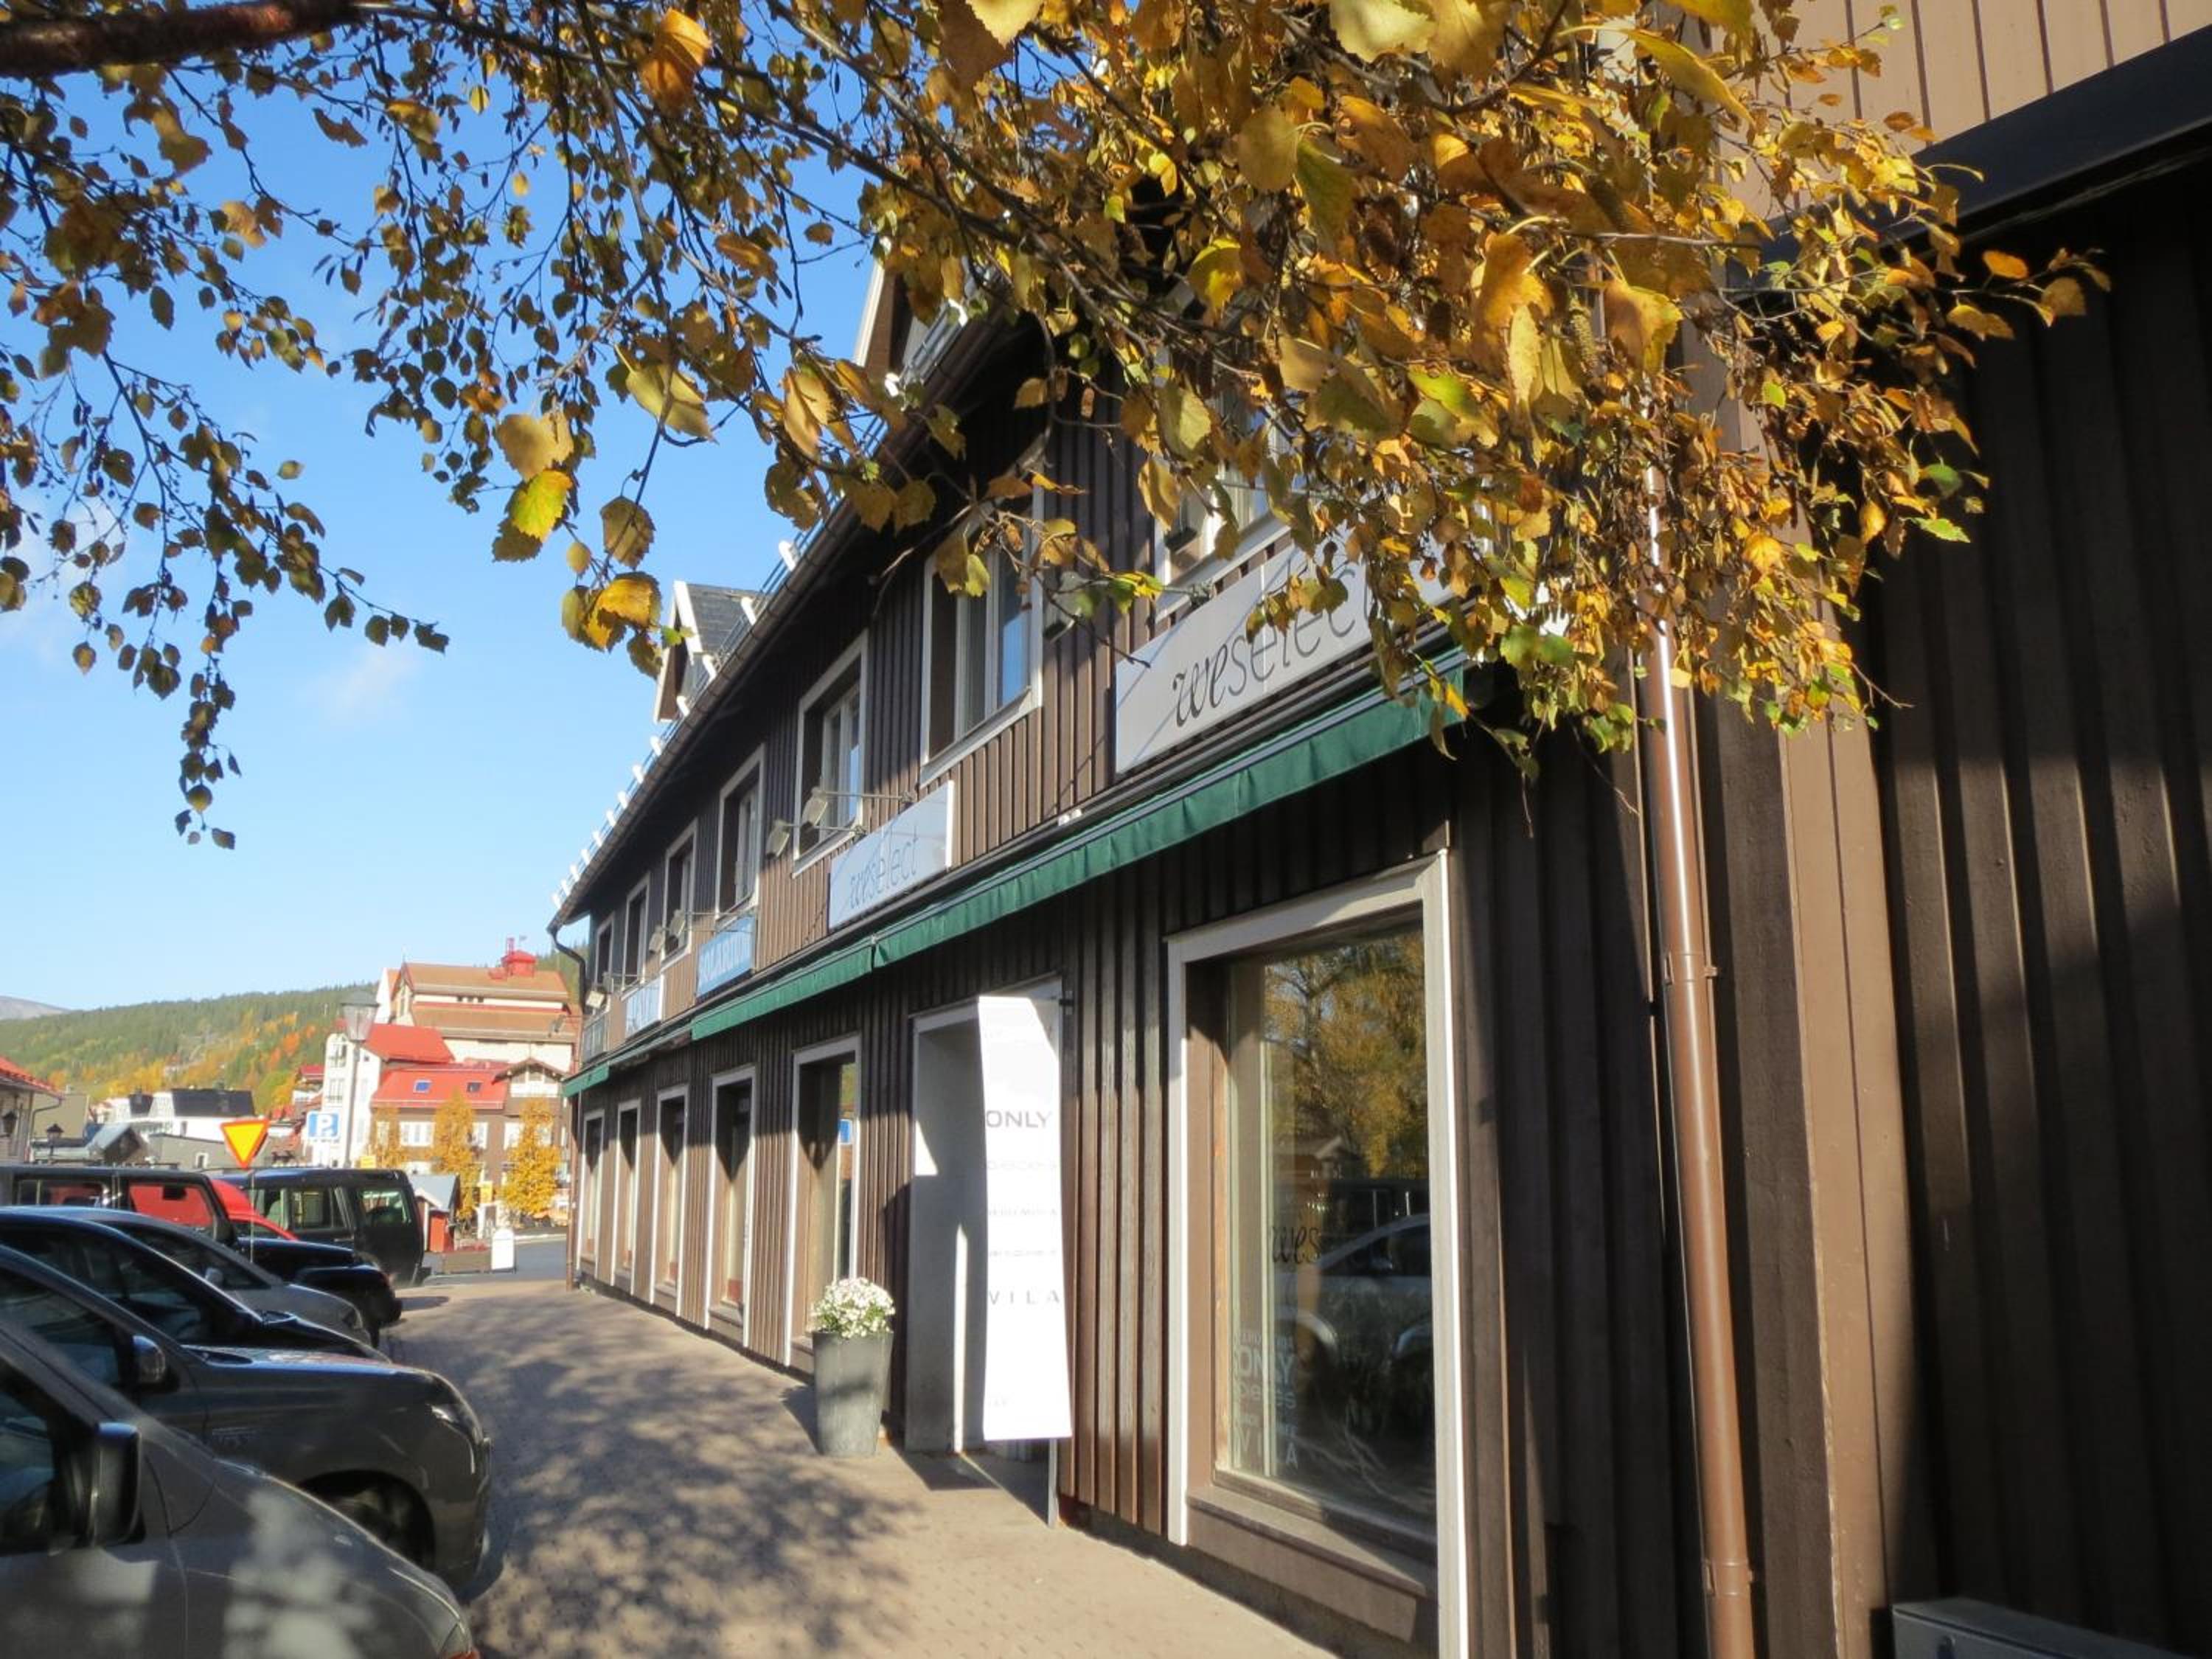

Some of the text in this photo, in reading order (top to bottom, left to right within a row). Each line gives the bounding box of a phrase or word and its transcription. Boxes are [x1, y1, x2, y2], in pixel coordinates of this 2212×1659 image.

[316, 1114, 333, 1136] P
[986, 1110, 1053, 1129] ONLY
[988, 1290, 1060, 1304] VILA
[1239, 1346, 1295, 1385] ONY
[1237, 1427, 1298, 1468] VIA
